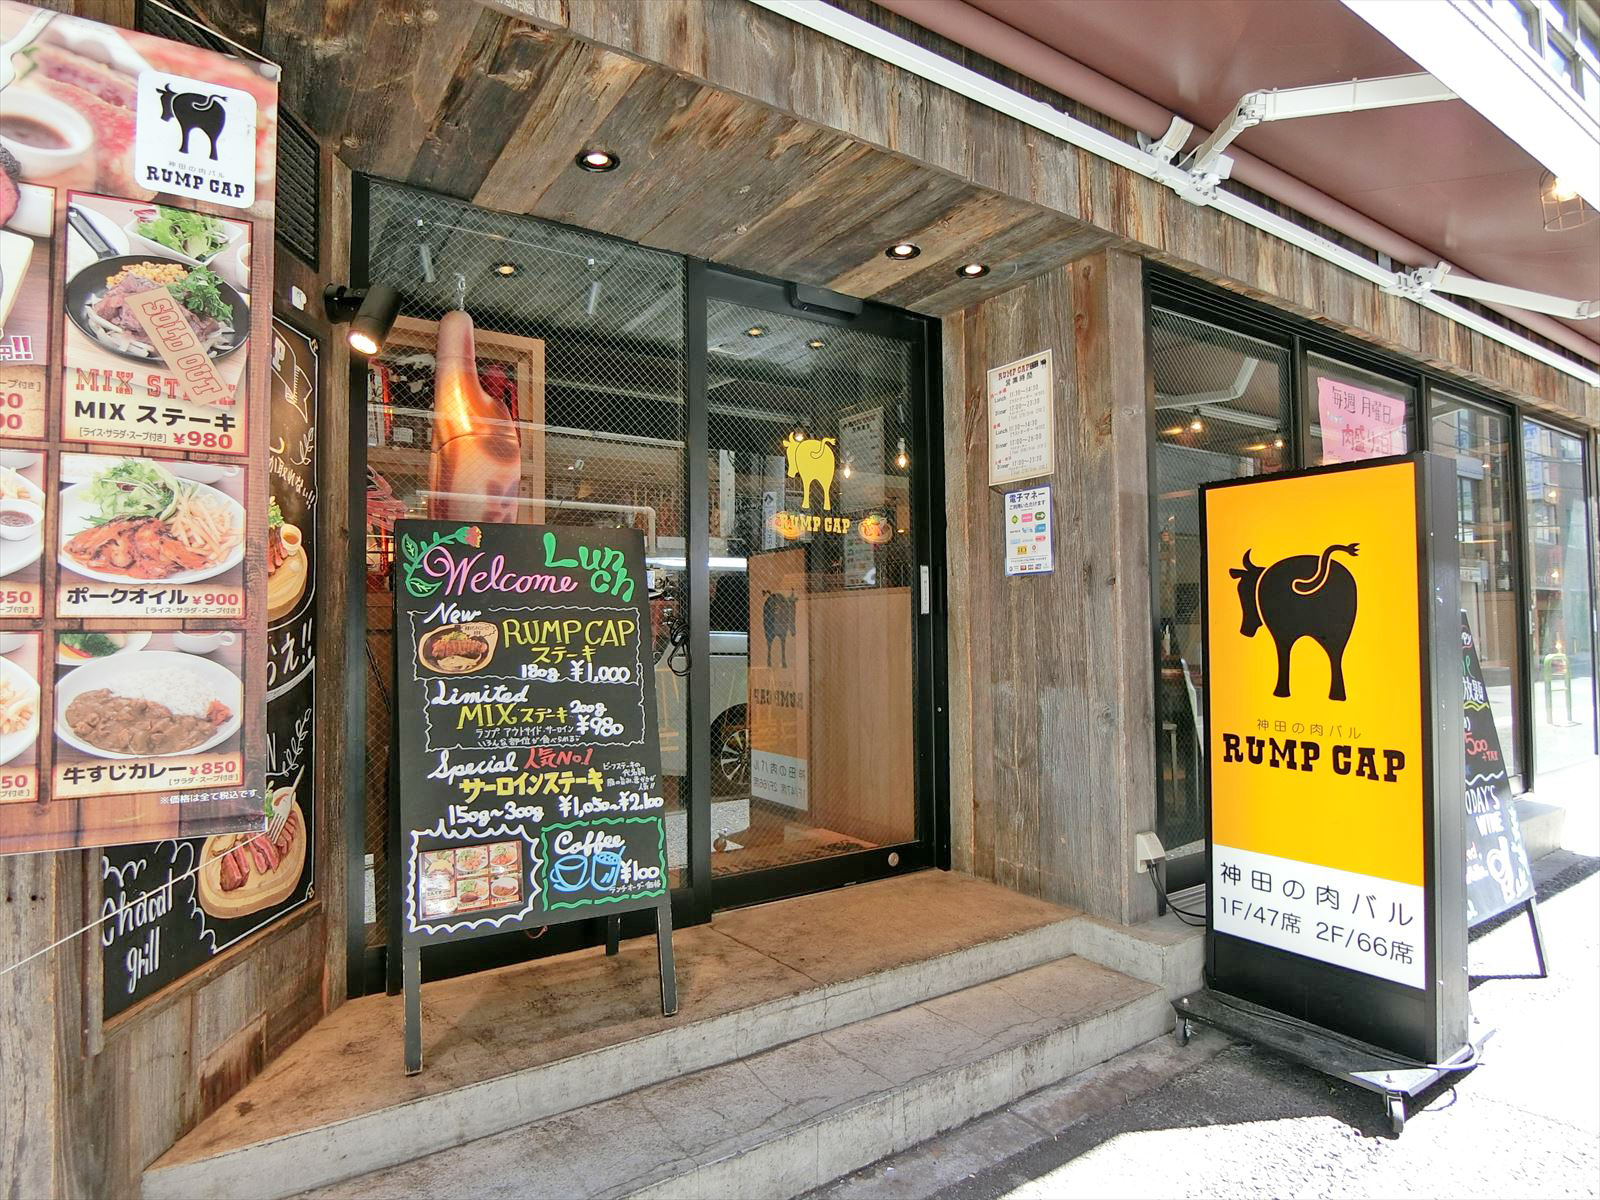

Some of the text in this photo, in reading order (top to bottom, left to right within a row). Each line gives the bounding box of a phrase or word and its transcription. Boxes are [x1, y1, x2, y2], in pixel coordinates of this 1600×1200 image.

[147, 166, 245, 198] RUMP CAP
[142, 297, 196, 353] SOLD
[176, 353, 223, 395] OUT
[75, 367, 134, 395] MIX
[74, 400, 236, 432] MIX ステーキ
[1332, 385, 1392, 425] 毎週 月曜日
[173, 431, 233, 449] ¥980
[1009, 490, 1046, 503] 電子マネー
[778, 513, 821, 532] RUMP
[824, 517, 851, 534] CAP
[422, 545, 579, 597] Welcome
[66, 586, 189, 605] ポークオイル
[192, 593, 239, 606] ¥900
[423, 602, 483, 625] New
[502, 618, 636, 649] RUMP CAP
[530, 646, 597, 664] ステーキ
[521, 659, 631, 683] 180g ¥1,000
[430, 680, 531, 706] Limited
[457, 703, 517, 730] MIX
[519, 706, 569, 725] ステーキ
[576, 714, 626, 737] ¥980
[1256, 718, 1362, 740] 神田の肉バル
[189, 760, 237, 776] ¥850
[426, 749, 519, 785] Special
[1222, 732, 1406, 783] RUMP CAP
[63, 763, 187, 785] 牛すじカレー
[459, 767, 605, 803] サーロインステーキ
[554, 830, 628, 857] Coffee
[620, 858, 660, 884] ¥100
[1220, 861, 1414, 927] 神田の肉バル
[1219, 896, 1415, 965] 1F/47席 2F/66席
[126, 926, 160, 993] grill
